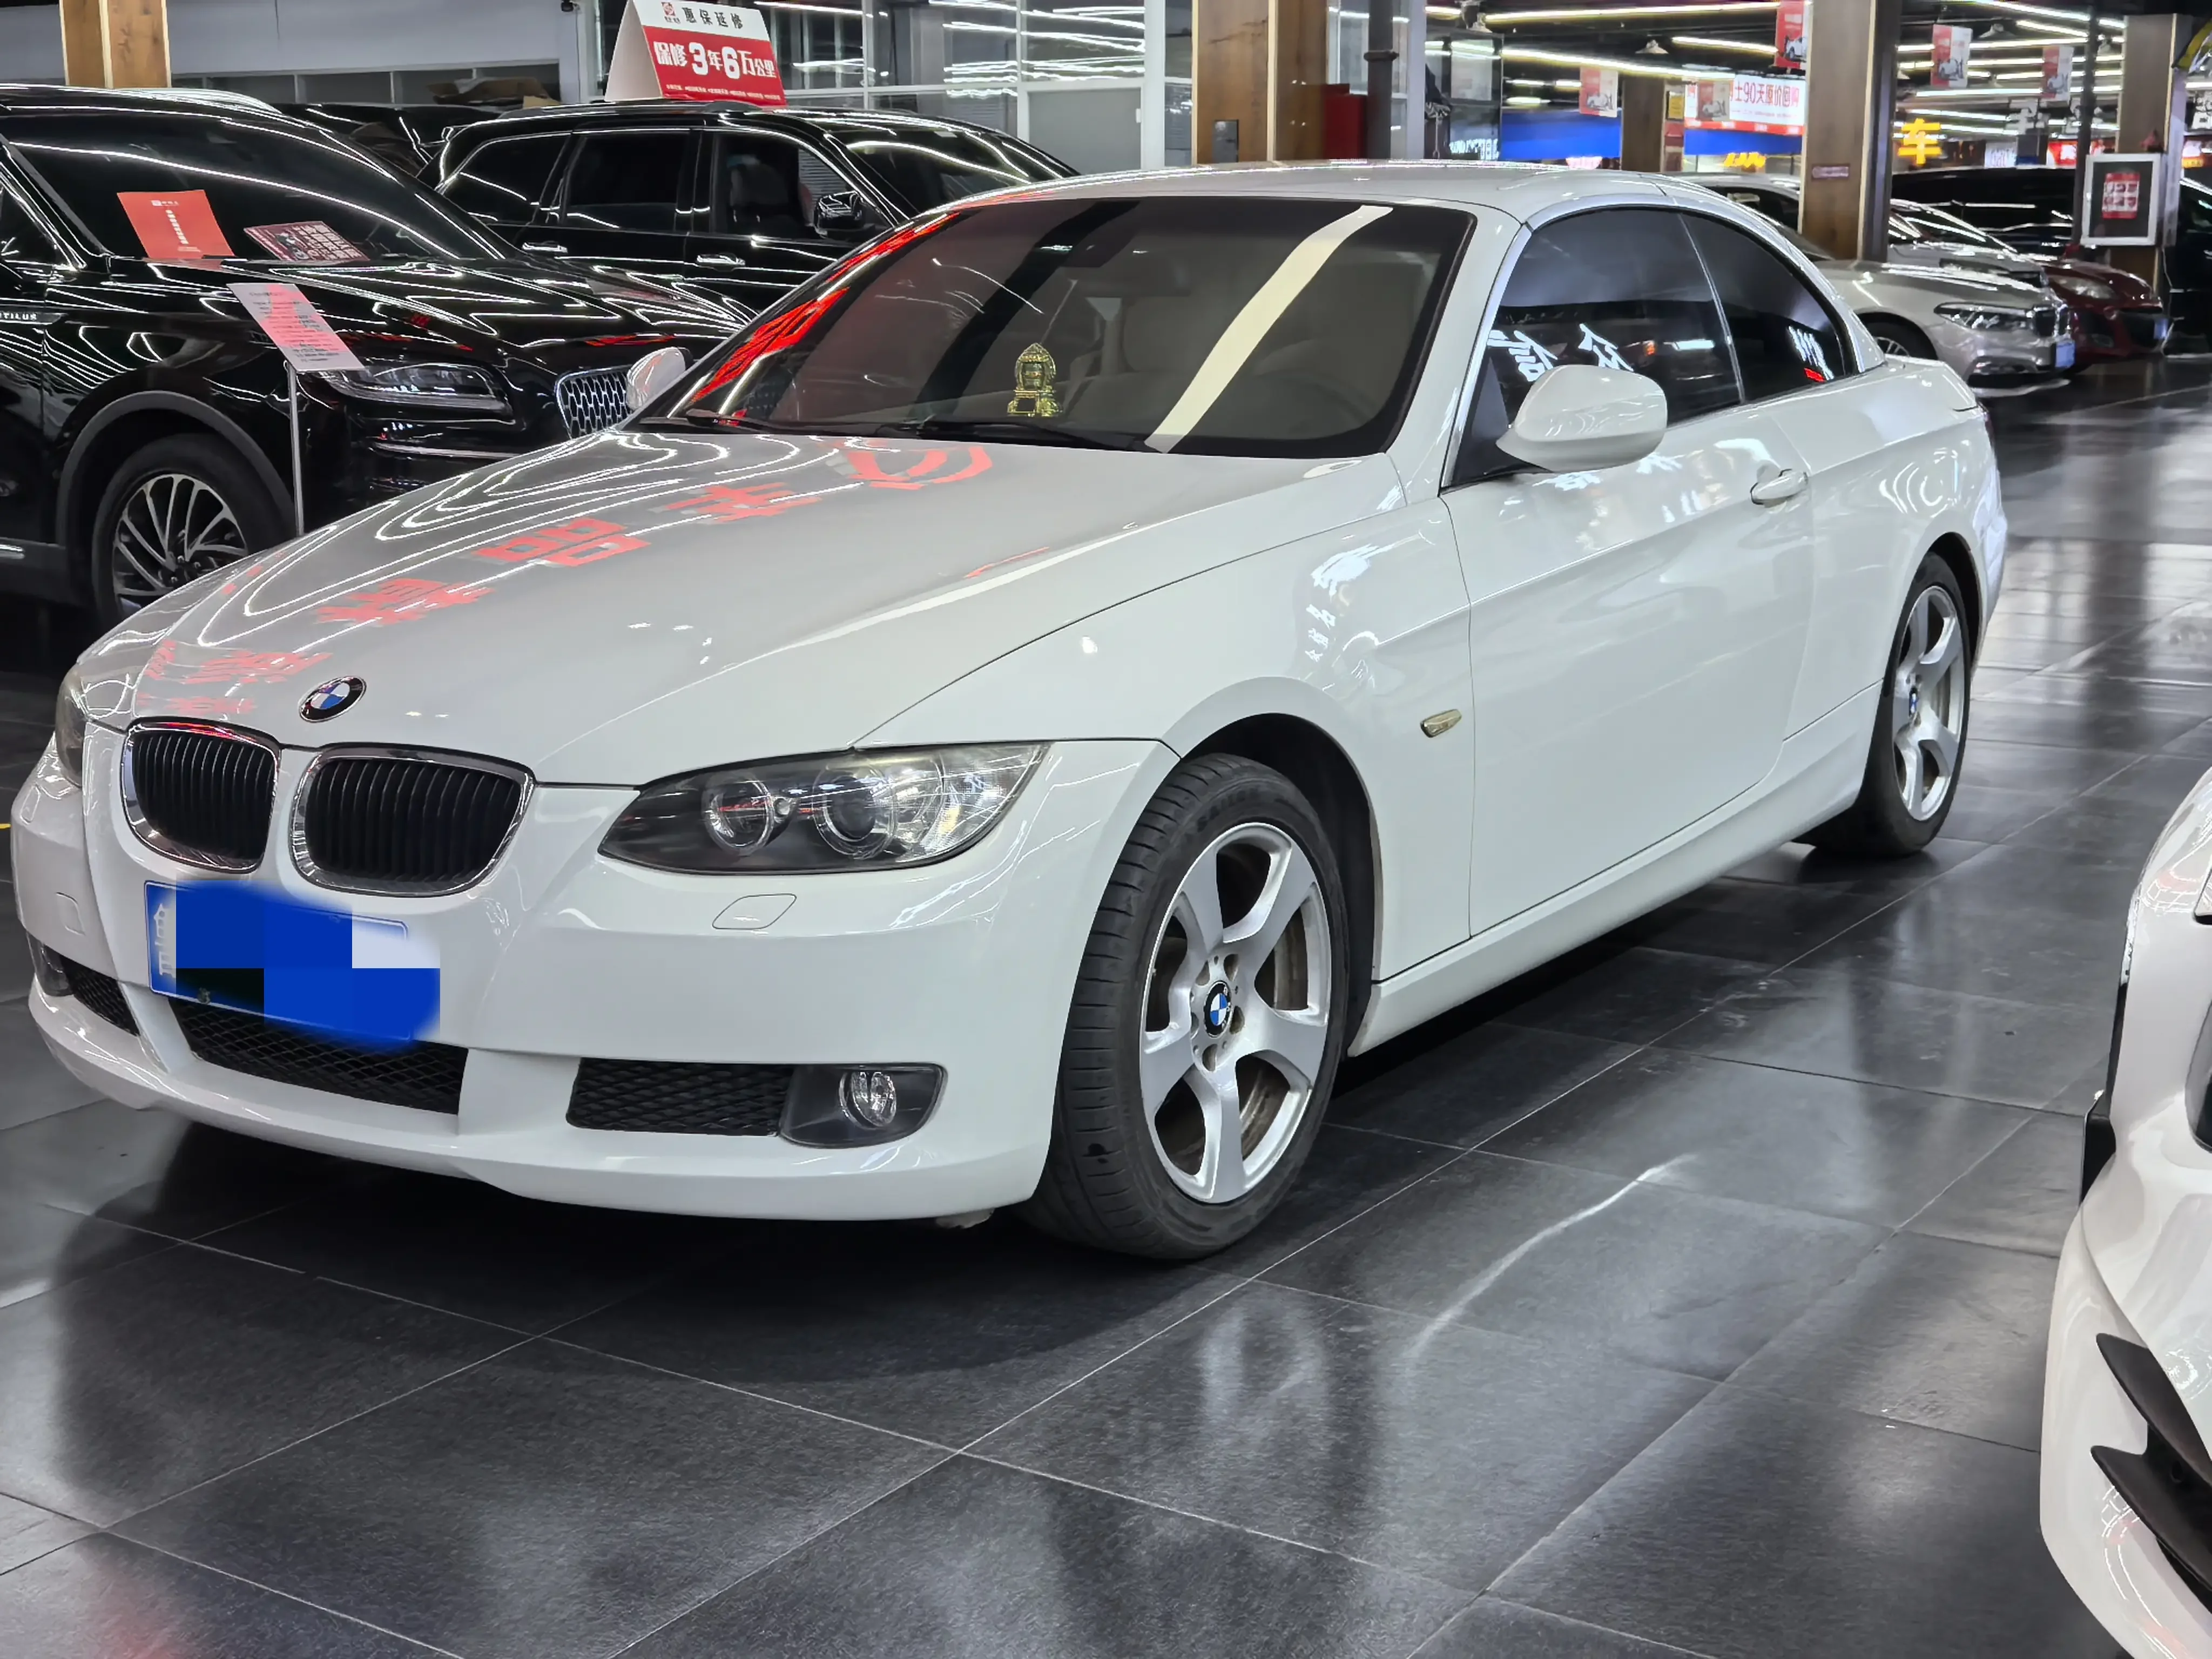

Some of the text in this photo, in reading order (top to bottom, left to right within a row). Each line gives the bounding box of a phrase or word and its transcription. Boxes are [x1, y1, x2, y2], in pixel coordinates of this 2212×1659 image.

[653, 41, 777, 79] 保修3年6万公里
[1730, 81, 1799, 107] 士90天原价回购
[1898, 118, 1943, 165] 车
[0, 312, 37, 321] TILUS
